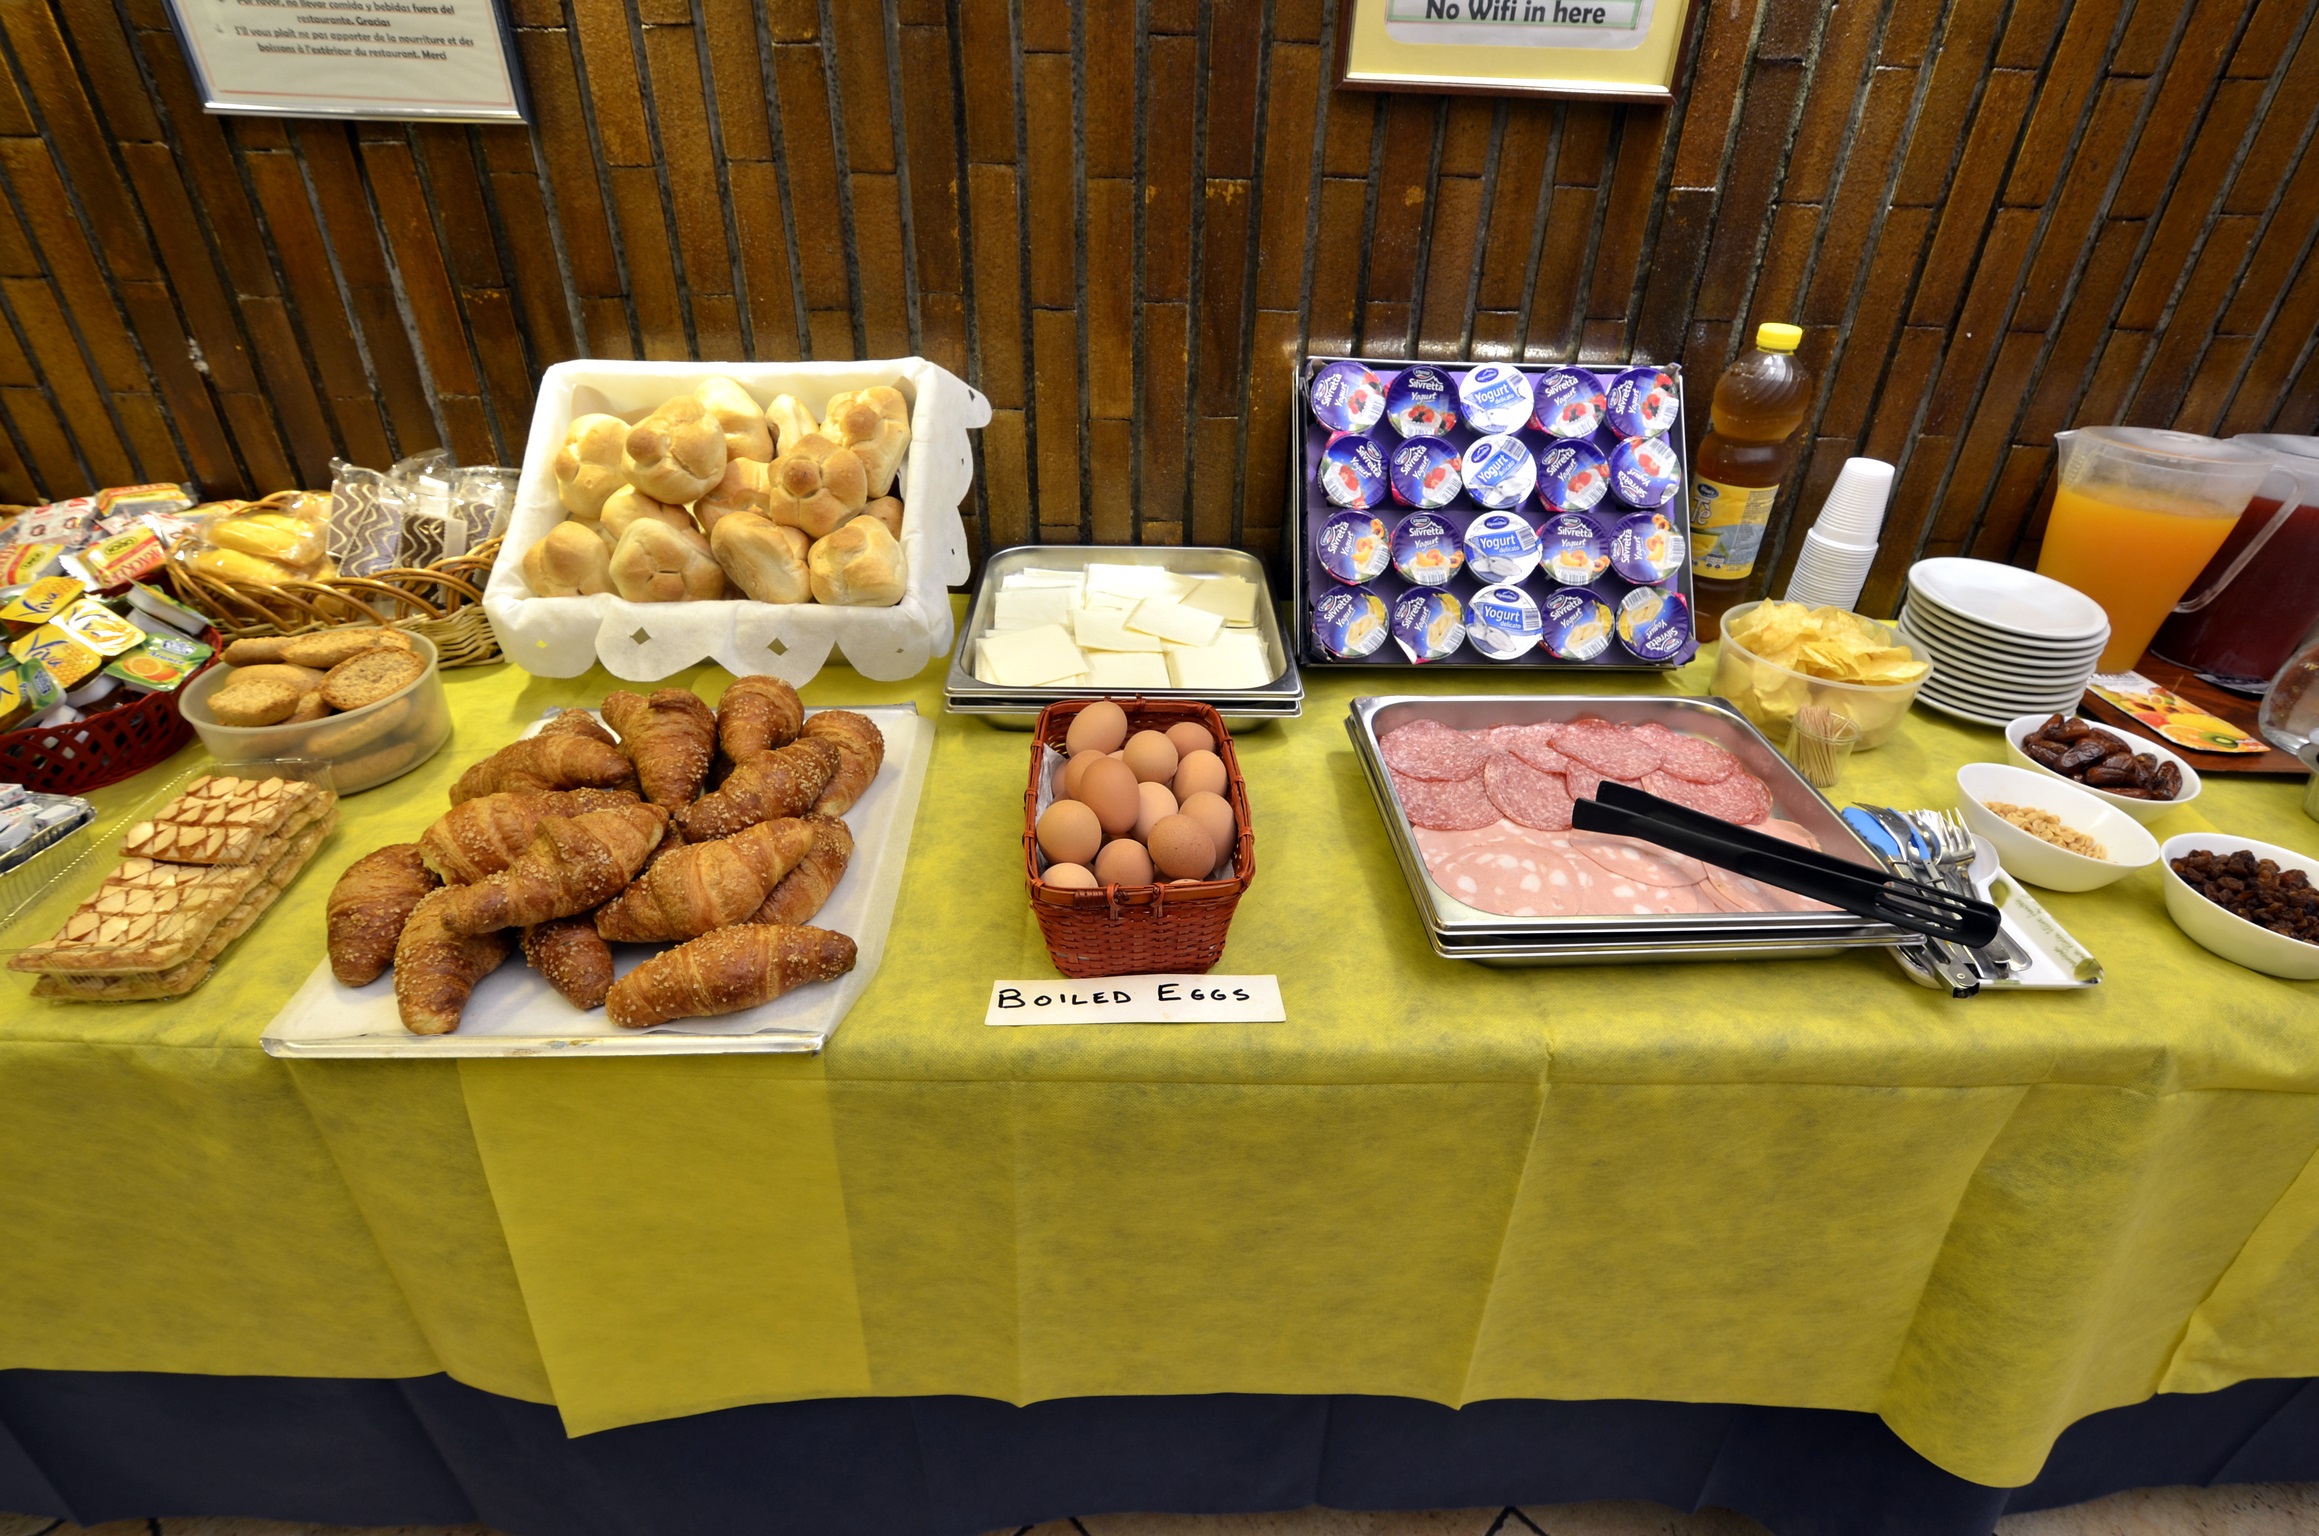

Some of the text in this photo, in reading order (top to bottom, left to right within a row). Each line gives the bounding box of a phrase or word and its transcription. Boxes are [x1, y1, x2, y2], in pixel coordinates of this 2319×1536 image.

[328, 1, 363, 10] comida
[365, 4, 373, 12] y
[373, 3, 411, 13] bebidas
[412, 3, 438, 14] fuera
[440, 5, 455, 15] del
[1426, 0, 1606, 24] No Wifi in here
[296, 15, 391, 27] restaurante. Gracias
[250, 28, 272, 37] vous
[298, 31, 310, 39] ne
[312, 31, 329, 40] pas
[330, 33, 371, 42] apporter
[373, 33, 385, 43] de
[386, 33, 397, 43] la
[398, 34, 446, 45] nourriture
[447, 37, 458, 46] et
[458, 37, 474, 47] des
[257, 42, 296, 53] boissons
[354, 47, 367, 57] du
[368, 49, 420, 59] restaurant.
[421, 50, 448, 60] Merci
[1321, 374, 1342, 407] Silvretta
[1408, 378, 1444, 391] Silvretta
[1474, 384, 1510, 404] Yogurt
[1545, 377, 1579, 398] Silvretta
[1411, 392, 1437, 404] Yogurt
[1554, 387, 1577, 406] Yogurt
[1616, 380, 1634, 415] Silvretta
[1351, 457, 1371, 479] Yogurt
[1356, 445, 1381, 478] Silvretta
[1400, 446, 1427, 476] Silvretta
[1412, 456, 1430, 480] Yogurt
[1478, 454, 1508, 483] Yogurt
[1546, 448, 1576, 476] Silvretta
[1558, 459, 1577, 482] Yogurt
[1618, 470, 1648, 499] Silvretta
[1328, 522, 1349, 555] Silvretta
[1341, 531, 1355, 556] Yogurt
[1408, 527, 1444, 537] Silvretta
[1414, 536, 1439, 551] Yogurt
[1480, 534, 1516, 550] Yogurt
[1557, 526, 1593, 538] Silvretta
[1561, 538, 1587, 550] Yogurt
[1621, 529, 1632, 564] Silvretta
[1324, 594, 1353, 623] Silvretta
[1335, 604, 1355, 627] Yogurt
[1402, 597, 1425, 629] Silvretta
[1414, 606, 1431, 631] Yogurt
[1484, 605, 1520, 622] Yogurt
[1550, 598, 1583, 621] Silvretta
[1560, 607, 1583, 628] Yogurt
[1645, 626, 1678, 650] Silvretta
[24, 633, 69, 668] Viva
[998, 983, 1251, 1009] BOILED EGGS
